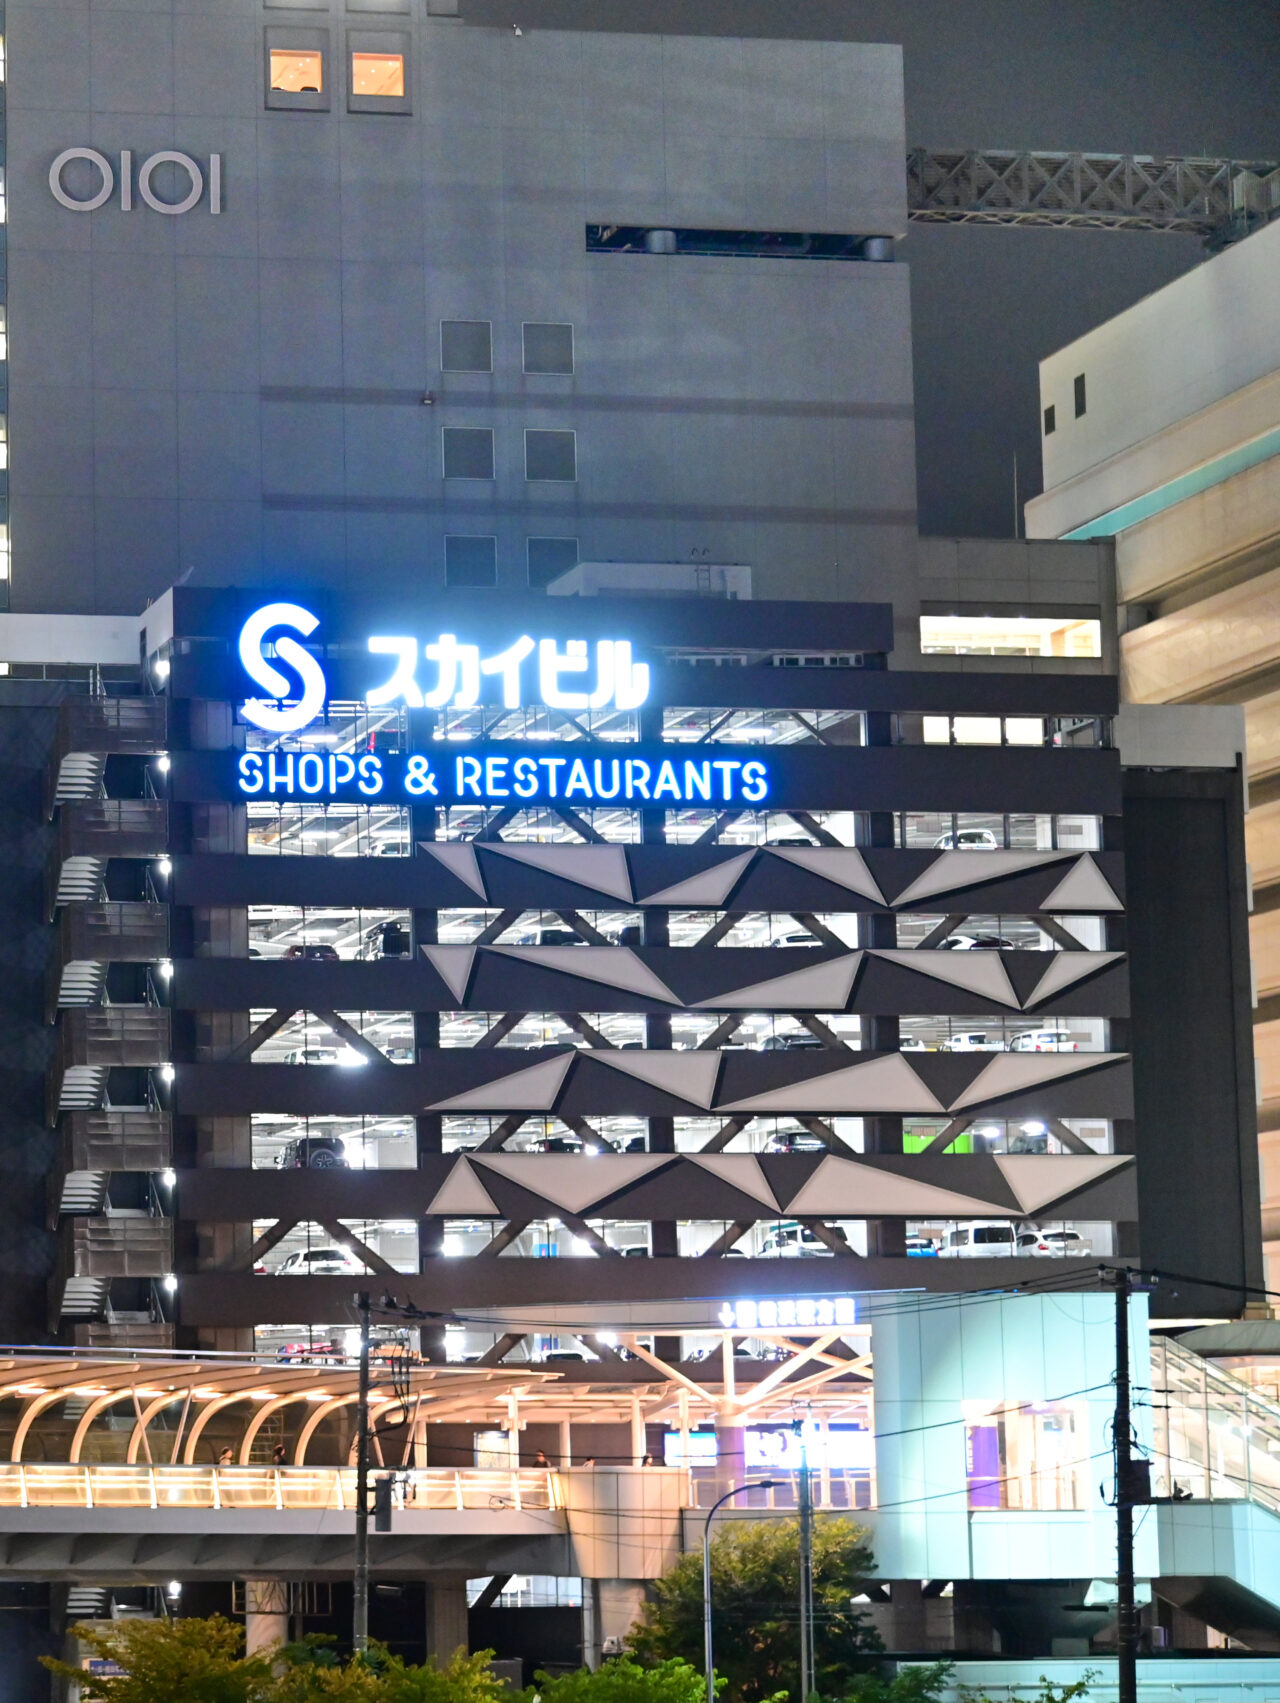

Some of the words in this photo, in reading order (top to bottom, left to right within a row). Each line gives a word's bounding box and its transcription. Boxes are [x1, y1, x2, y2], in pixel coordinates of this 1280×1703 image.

[365, 633, 651, 711] スカイビル
[237, 753, 383, 795] SHOPS
[404, 754, 439, 796] &
[455, 755, 769, 802] RESTAURANTS
